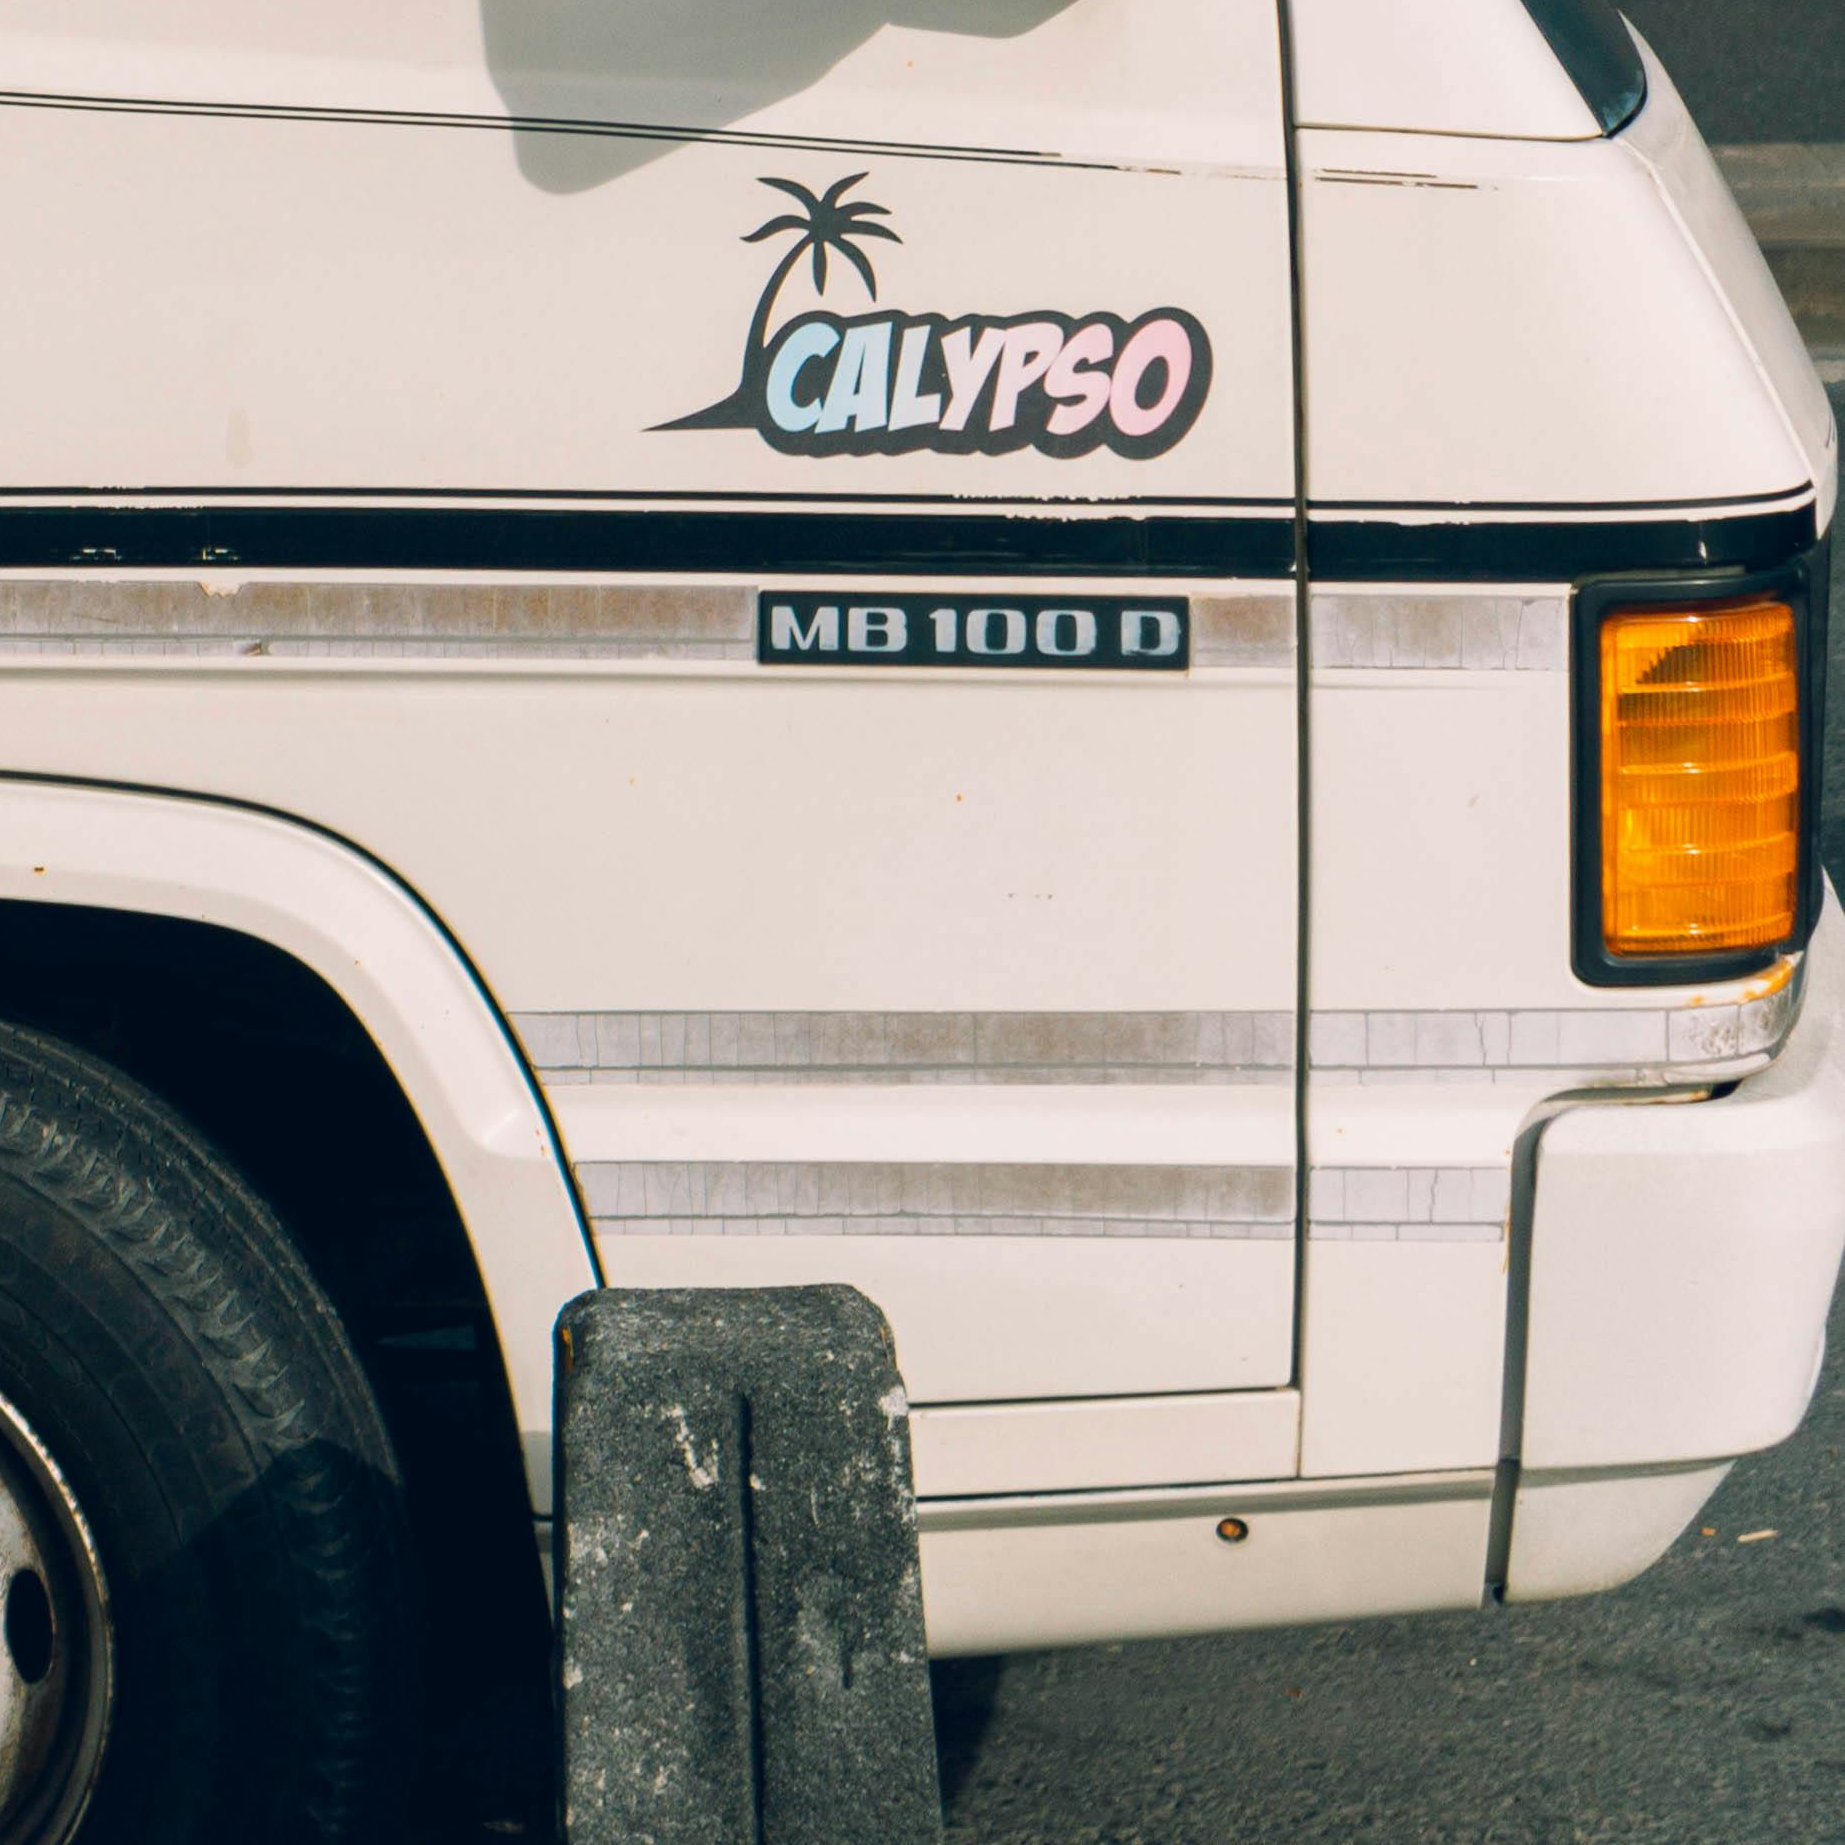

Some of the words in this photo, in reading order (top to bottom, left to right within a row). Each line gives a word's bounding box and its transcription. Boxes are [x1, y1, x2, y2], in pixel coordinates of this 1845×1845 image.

[762, 313, 1198, 441] CALYPSO
[770, 605, 908, 653] MB
[928, 608, 1098, 656] 100
[1120, 609, 1182, 657] D
